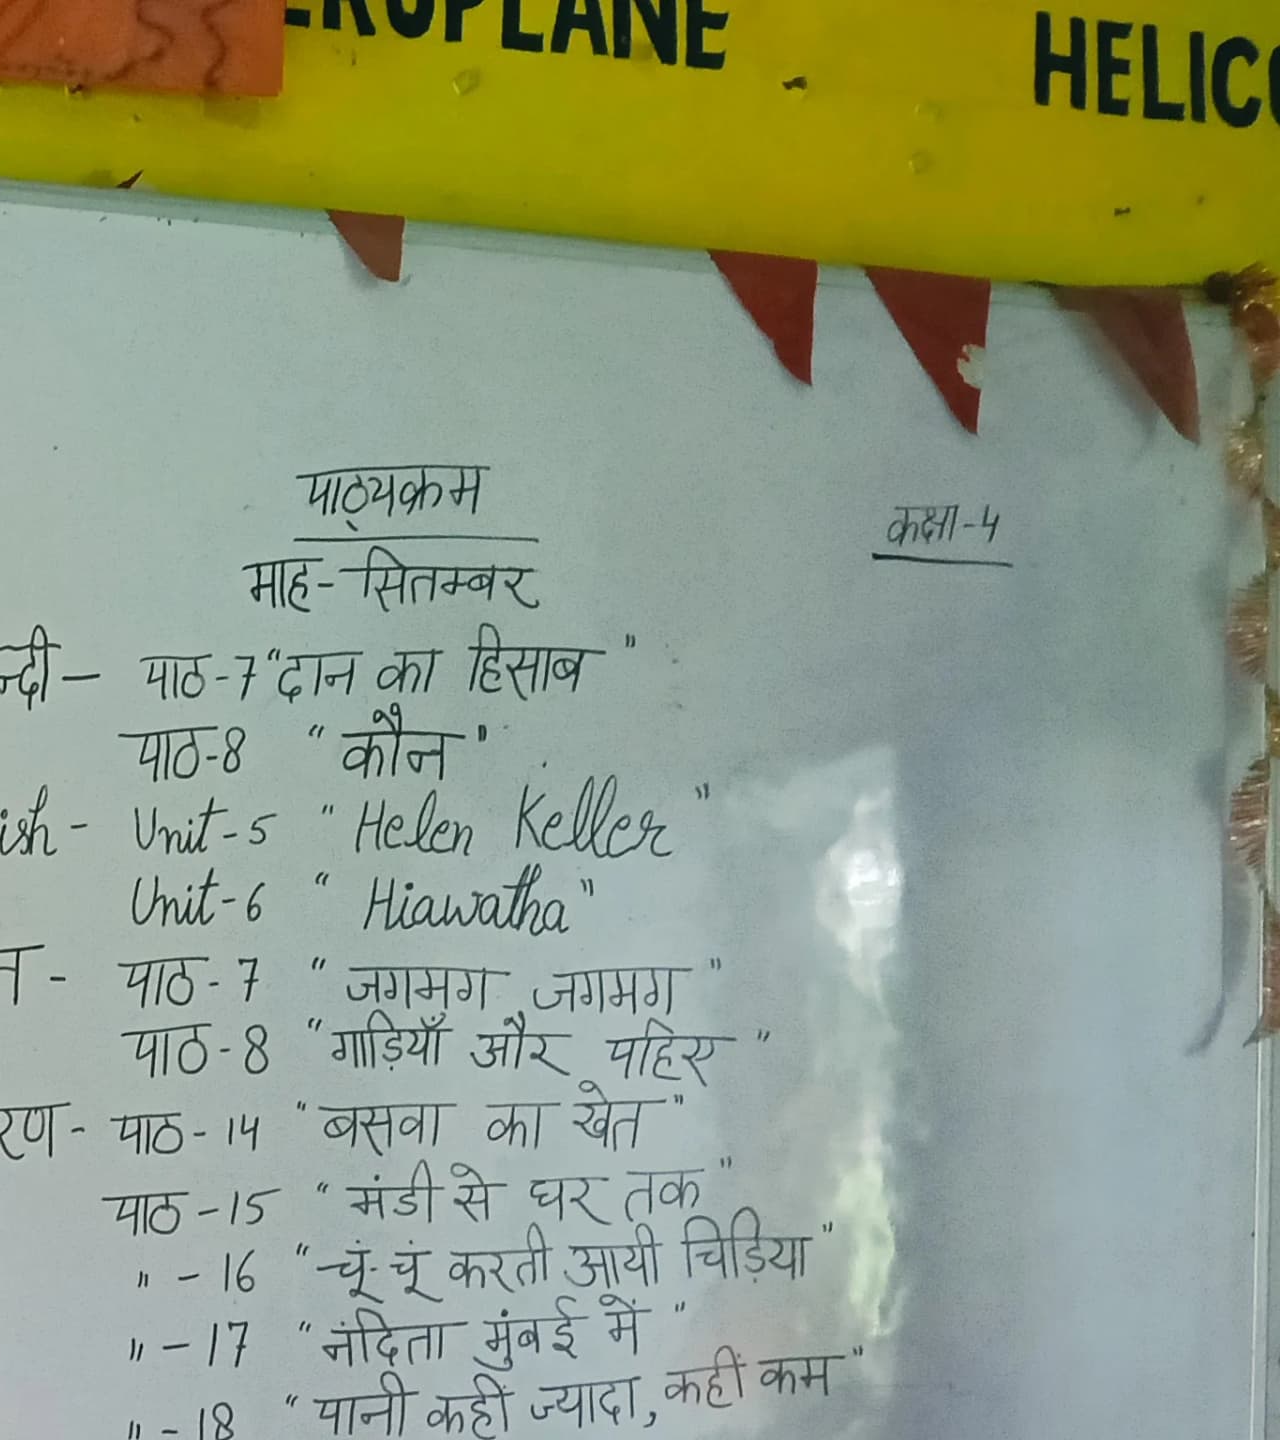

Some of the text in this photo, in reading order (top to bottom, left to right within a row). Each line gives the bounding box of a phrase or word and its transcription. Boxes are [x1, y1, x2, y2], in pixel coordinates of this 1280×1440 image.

[1034, 10, 1280, 128] HELIC
[339, 545, 539, 609] सितम्बर
[376, 650, 444, 694] का
[469, 1010, 573, 1077] और
[485, 1102, 562, 1150] का
[451, 1161, 509, 1223] से
[528, 1176, 613, 1226] घर
[448, 1222, 554, 1294] करती
[563, 1222, 665, 1290] आयी
[472, 1295, 589, 1372] मुंबई
[426, 1372, 516, 1440] कहीं
[664, 1344, 748, 1410] कहीं
